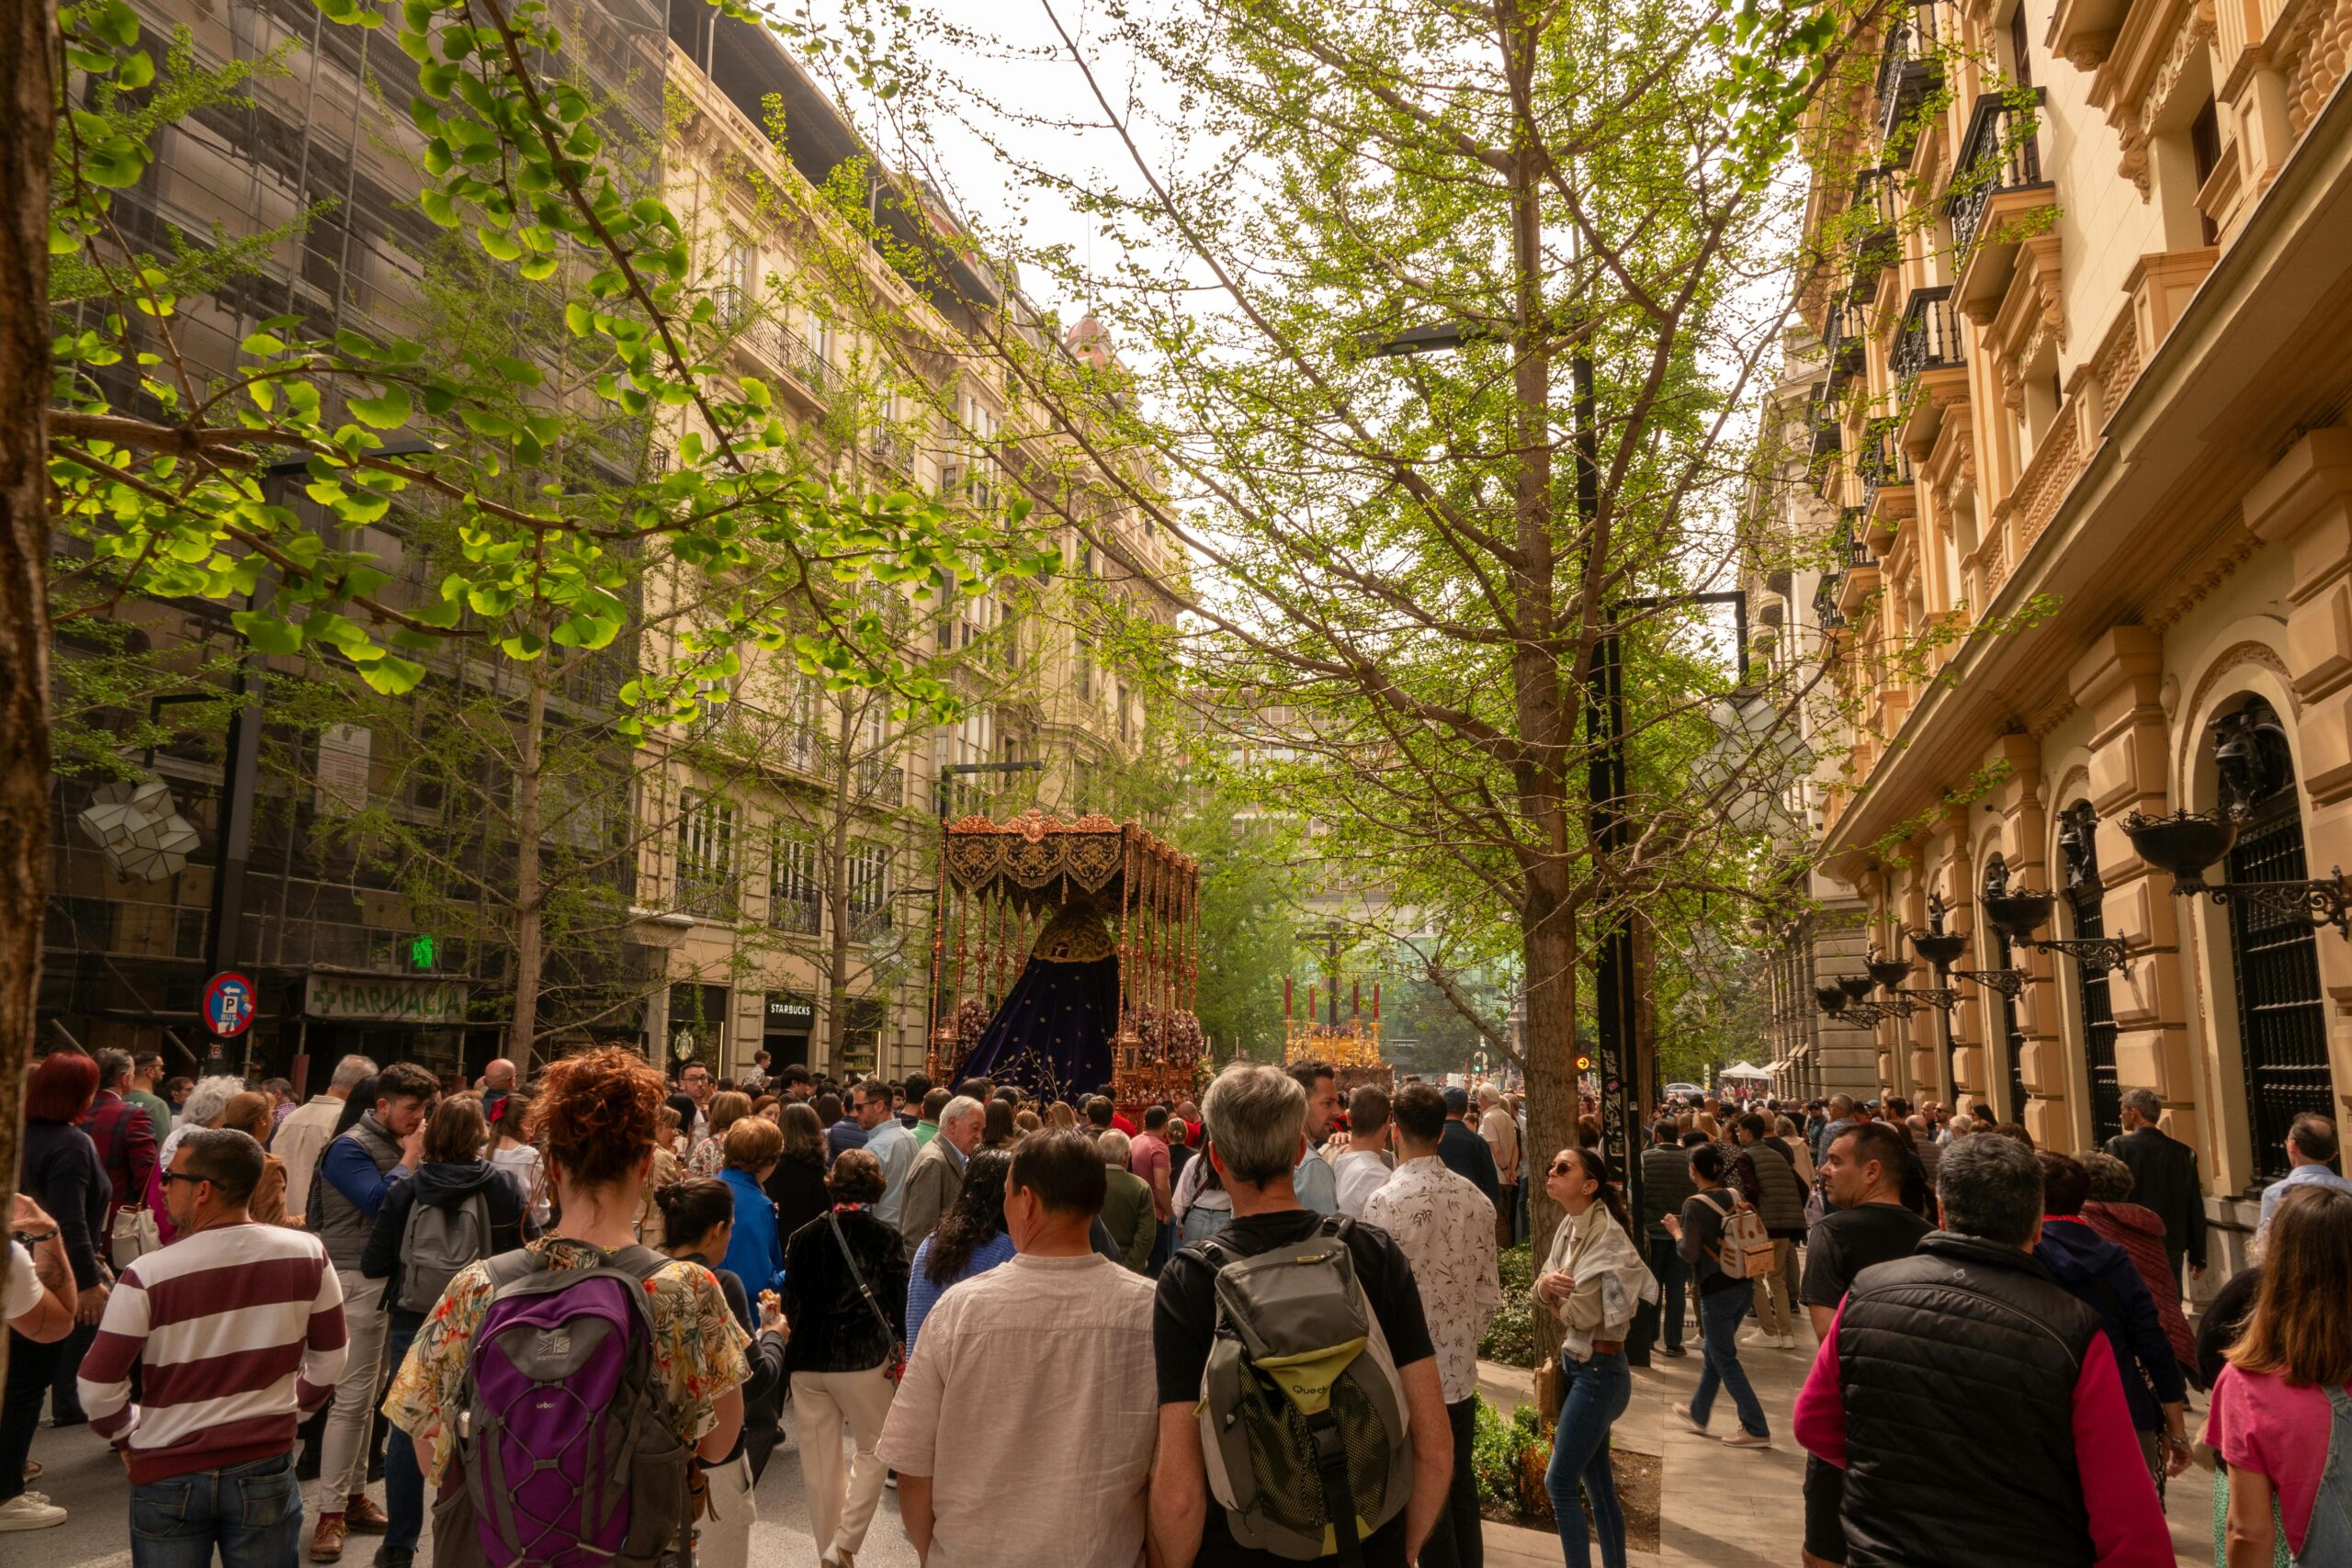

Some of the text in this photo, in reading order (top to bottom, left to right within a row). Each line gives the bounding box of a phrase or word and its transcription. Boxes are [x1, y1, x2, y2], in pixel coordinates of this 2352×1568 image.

[225, 998, 235, 1011] P
[339, 984, 459, 1015] FARMACIA
[771, 1004, 810, 1015] STARBUCKS
[220, 1013, 237, 1021] BUS
